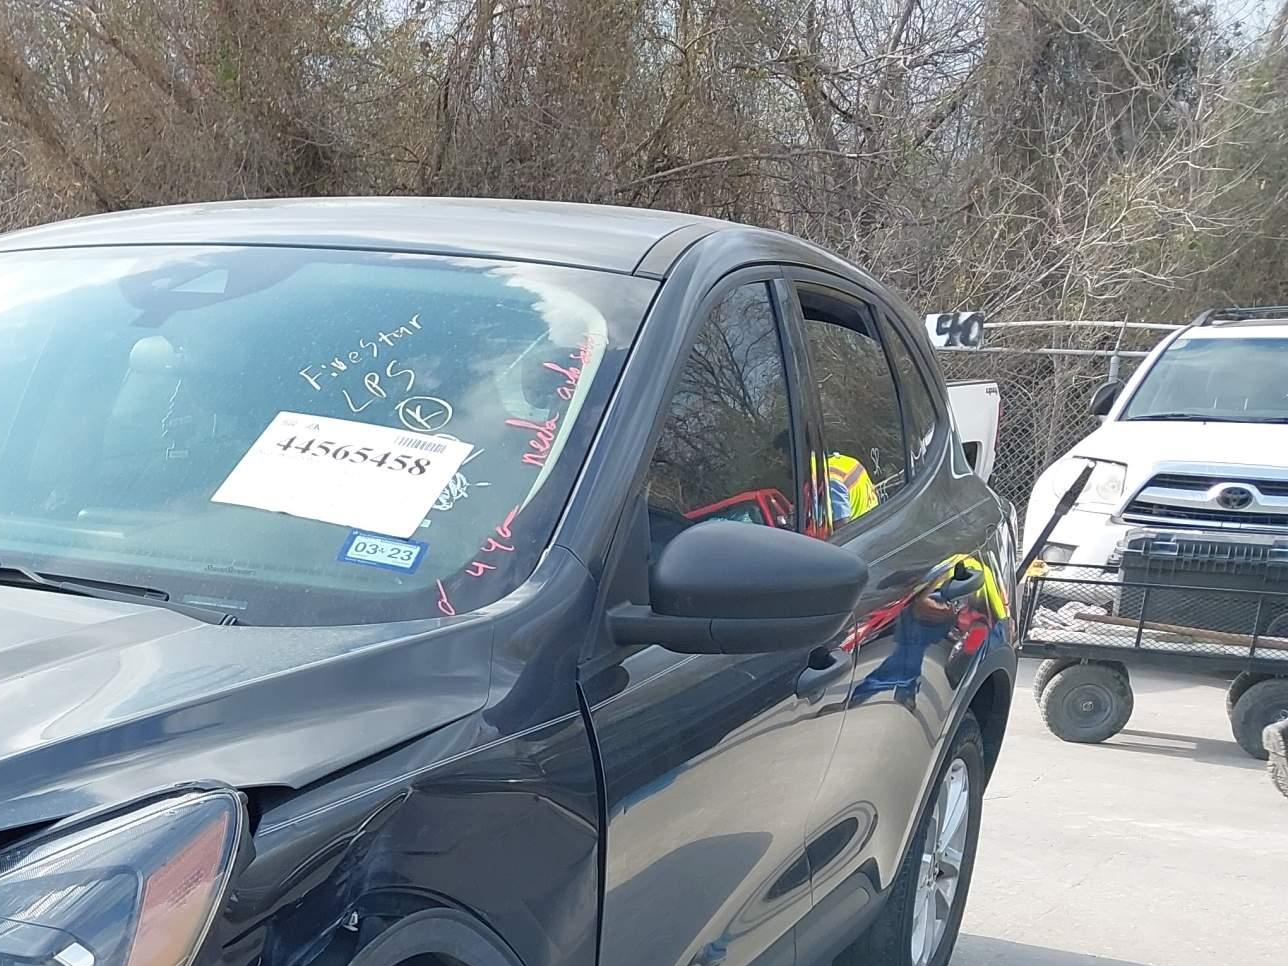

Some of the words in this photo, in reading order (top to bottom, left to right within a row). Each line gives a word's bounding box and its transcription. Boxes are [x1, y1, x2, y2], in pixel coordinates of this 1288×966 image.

[343, 359, 415, 413] LPS
[276, 435, 431, 476] 44565458
[354, 541, 380, 555] 03
[387, 547, 414, 561] 23
